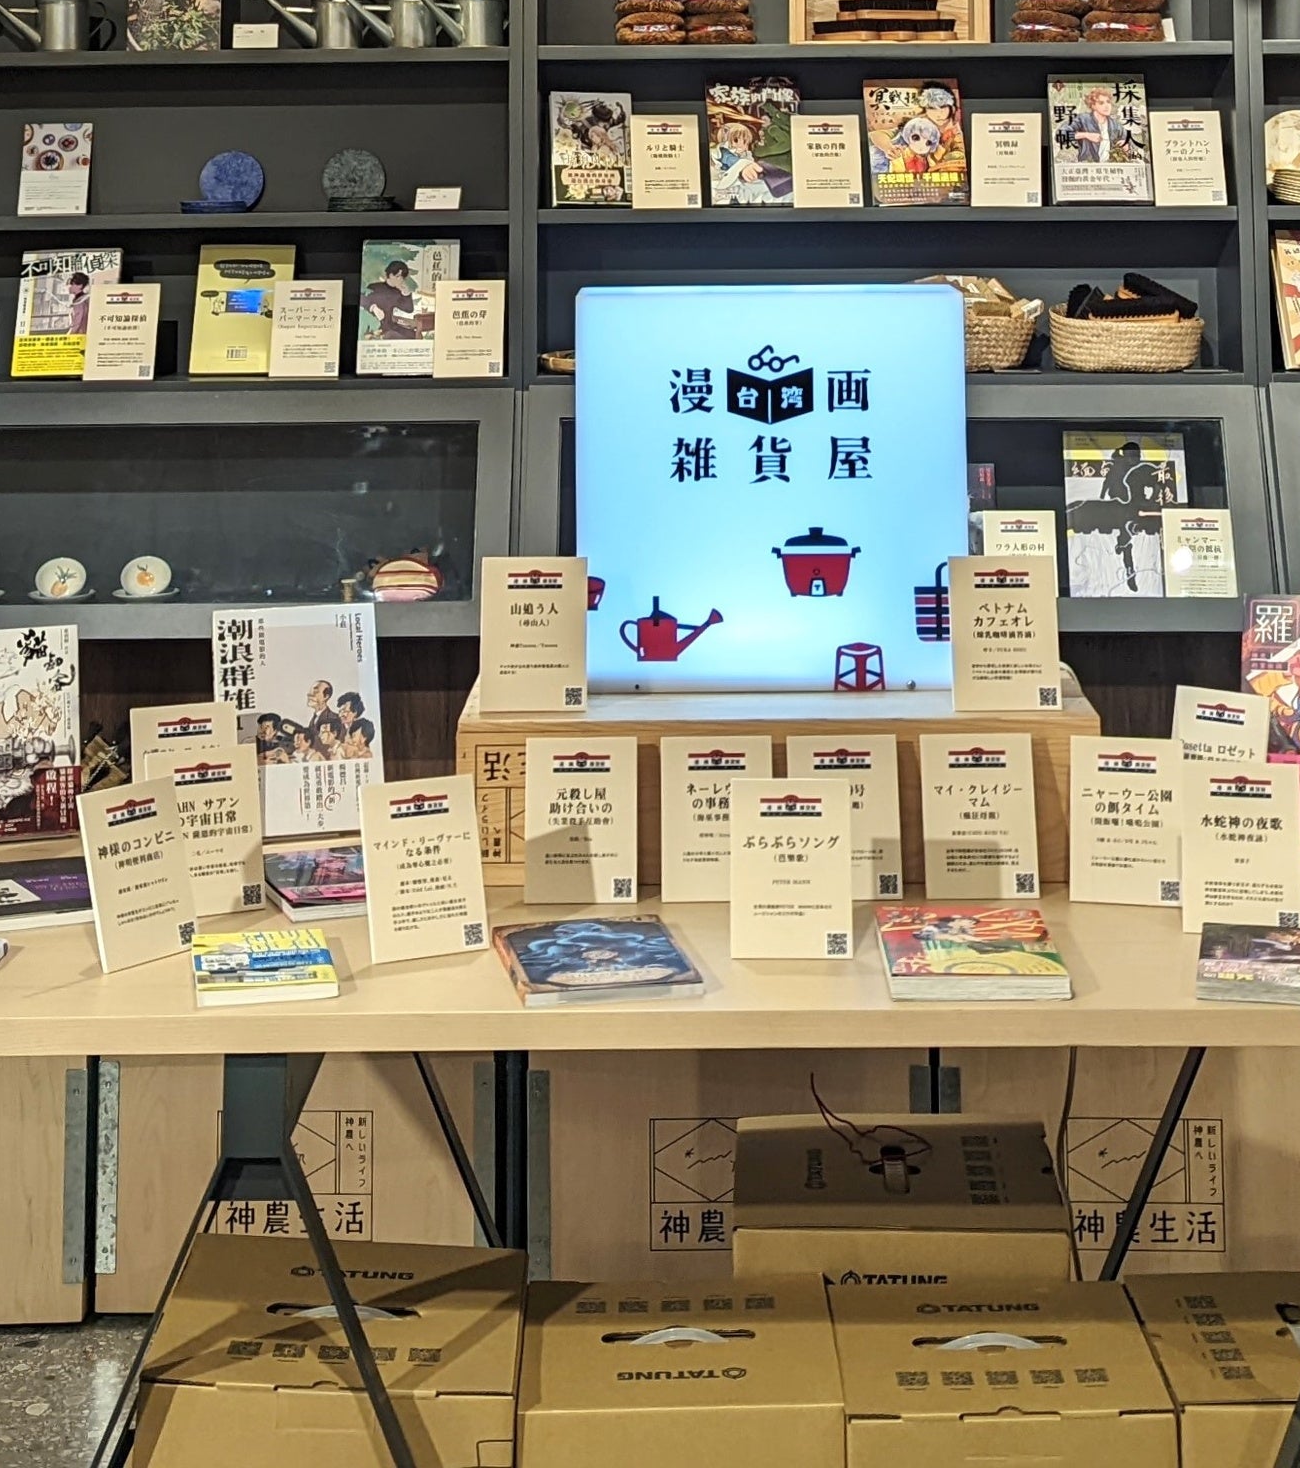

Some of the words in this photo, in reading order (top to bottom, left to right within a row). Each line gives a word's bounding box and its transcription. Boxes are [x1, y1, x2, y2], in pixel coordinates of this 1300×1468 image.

[431, 250, 443, 291] 芭蕉的
[669, 435, 872, 483] 雑貨屋
[979, 602, 1027, 615] ベトナム
[354, 612, 363, 634] Local
[973, 615, 1034, 628] カフェオレ
[356, 635, 364, 663] Heroes
[217, 618, 256, 711] 潮浪群雄
[1217, 745, 1255, 760] ロゼット
[556, 787, 607, 801] 元殺し屋
[933, 783, 1023, 795] マイ・クレイジー
[1081, 787, 1173, 804] ニャーウー公園
[203, 797, 240, 810] サアン
[549, 801, 613, 815] 助け合いの
[968, 797, 991, 807] マム
[1094, 801, 1159, 816] の餌タイム
[1199, 814, 1284, 831] 水蛇神の夜歌
[98, 829, 175, 860] 神様のコンビニ
[742, 835, 840, 850] ぶらぶらソング
[405, 845, 441, 858] なる条件
[357, 1116, 368, 1188] 新しいライフ
[659, 1209, 726, 1244] 神農
[318, 1269, 414, 1281] TUNG
[939, 1302, 1040, 1313] TATUNG
[616, 1369, 721, 1381] TATUNG
